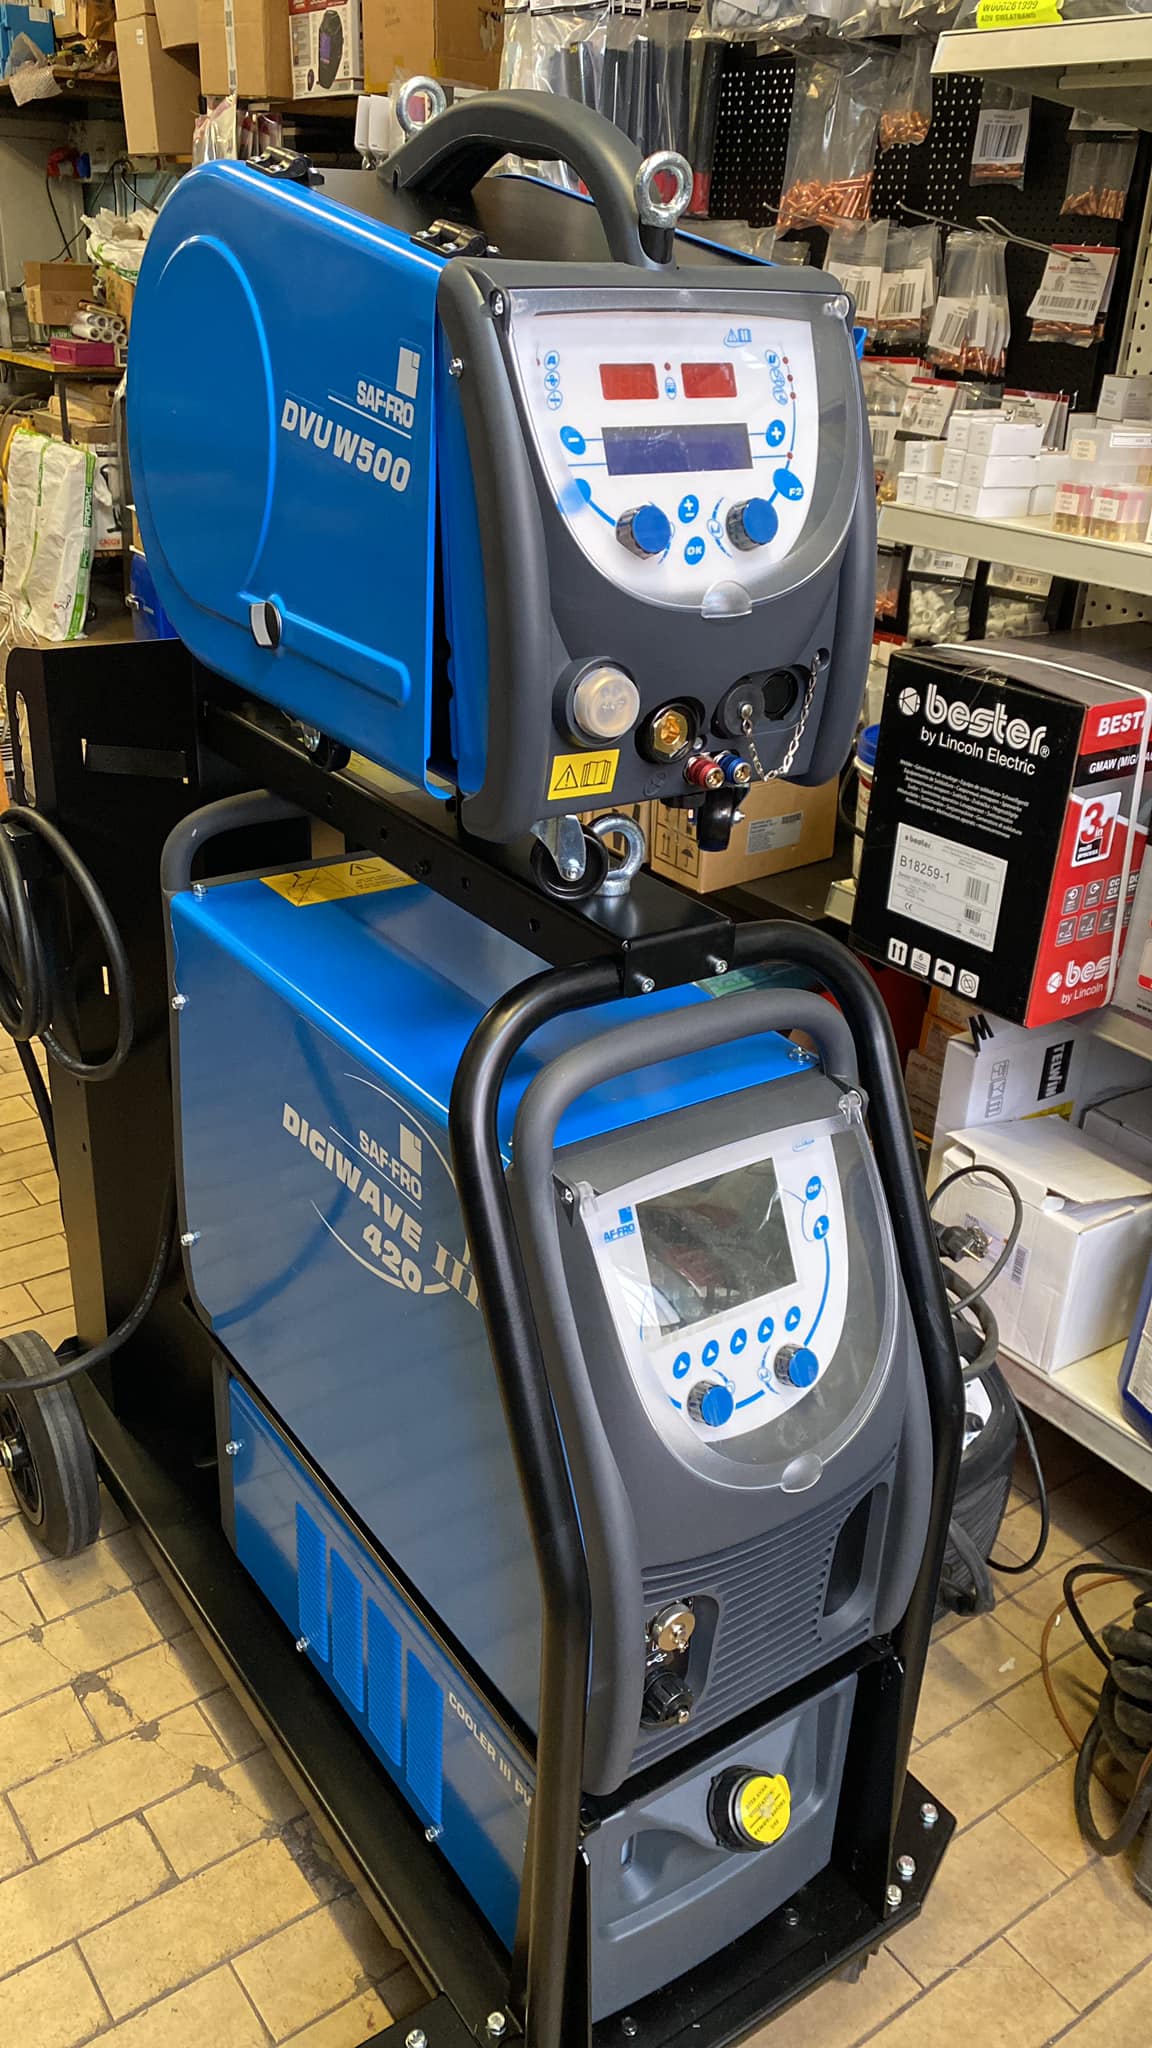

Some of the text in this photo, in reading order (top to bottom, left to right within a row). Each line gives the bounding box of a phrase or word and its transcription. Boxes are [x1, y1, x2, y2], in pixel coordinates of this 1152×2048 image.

[356, 380, 415, 430] SAF-FRO
[788, 487, 803, 497] F2
[686, 545, 702, 556] OK
[925, 683, 1047, 755] bester
[920, 726, 1036, 776] by Lincoln Electric
[1089, 757, 1118, 774] GMAW
[899, 855, 951, 884] B18259-1
[1061, 982, 1104, 1004] by Lincoln
[1045, 1043, 1066, 1098] TELWIN
[282, 1102, 423, 1252] DIGIWAVE
[359, 1129, 422, 1201] SAF-FRO
[362, 1223, 422, 1293] 420
[449, 1692, 496, 1761] COOLER
